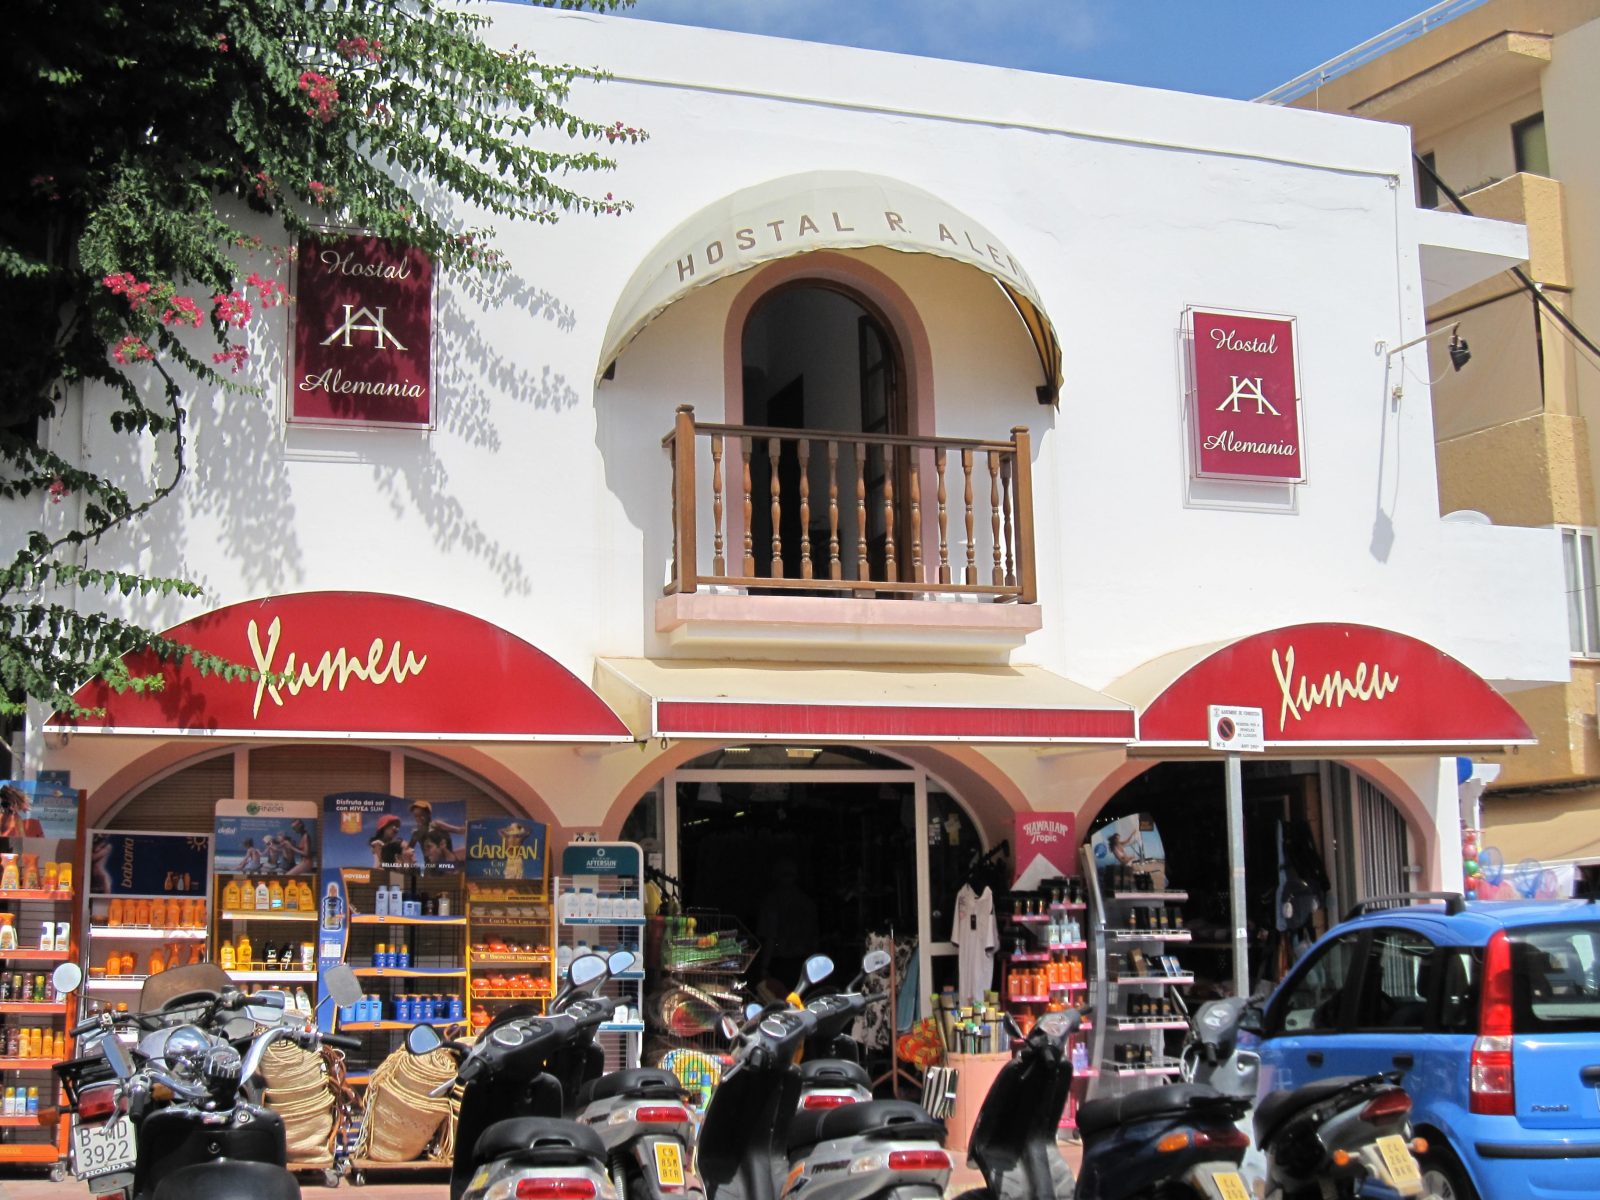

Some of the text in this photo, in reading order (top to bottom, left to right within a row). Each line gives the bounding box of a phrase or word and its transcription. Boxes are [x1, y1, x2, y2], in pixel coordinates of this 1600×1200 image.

[676, 212, 855, 282] HOSTAL
[884, 211, 913, 234] R.
[320, 250, 411, 280] Hostal
[1210, 328, 1279, 354] Hostal
[299, 368, 426, 398] Alemania
[1203, 430, 1297, 456] Alemania
[1023, 820, 1069, 837] HAWAIIAN
[1027, 831, 1057, 845] Tropic
[121, 837, 135, 888] babaria
[83, 1140, 129, 1168] 3922
[85, 1162, 130, 1177] HONDA
